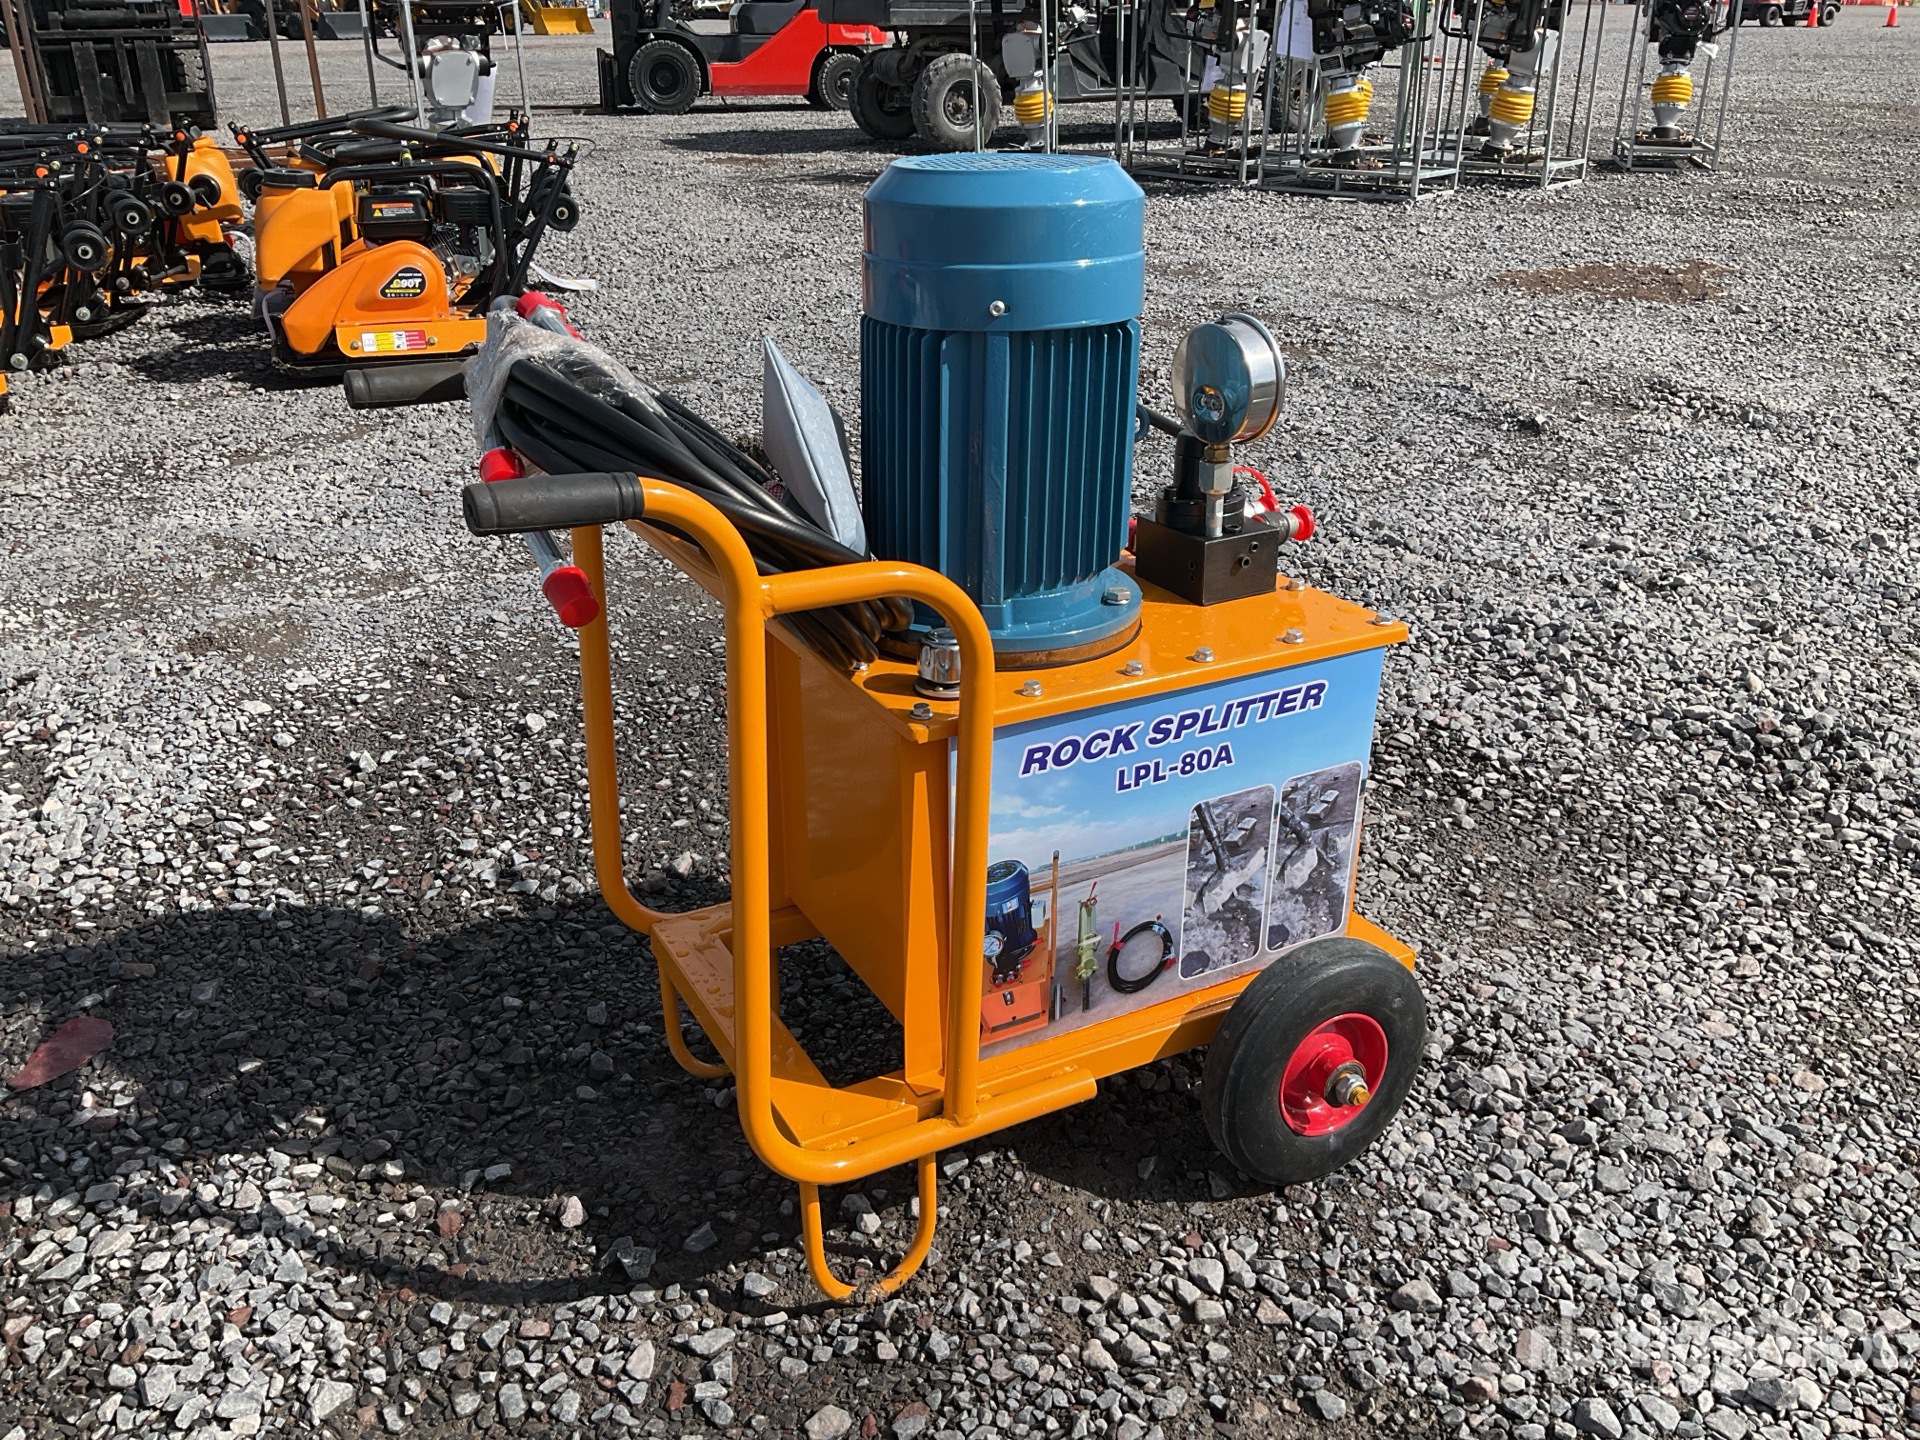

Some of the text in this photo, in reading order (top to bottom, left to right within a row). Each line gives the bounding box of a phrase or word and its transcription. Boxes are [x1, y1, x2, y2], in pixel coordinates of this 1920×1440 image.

[1020, 681, 1328, 776] ROCK SPLITTER
[1116, 743, 1234, 792] LPL-80A
